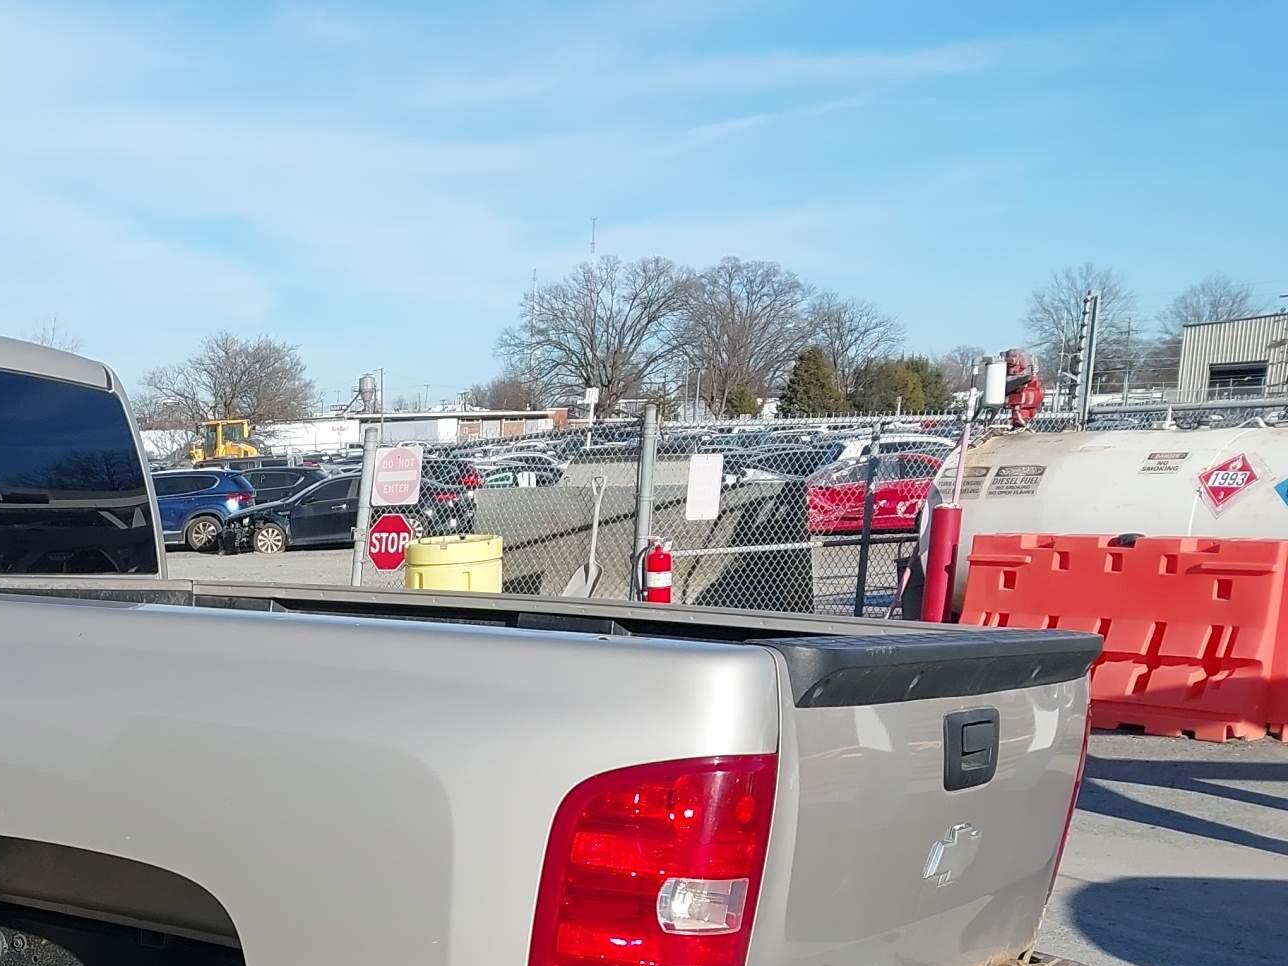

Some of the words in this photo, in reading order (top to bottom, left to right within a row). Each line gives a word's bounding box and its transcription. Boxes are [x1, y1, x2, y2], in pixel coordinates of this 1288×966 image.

[382, 460, 394, 469] DO
[399, 458, 416, 468] NOT
[992, 477, 1018, 485] DIESEL
[1020, 476, 1039, 485] FUEL
[1212, 472, 1247, 486] 1993
[383, 484, 410, 494] ENTER
[370, 532, 410, 554] STOP
